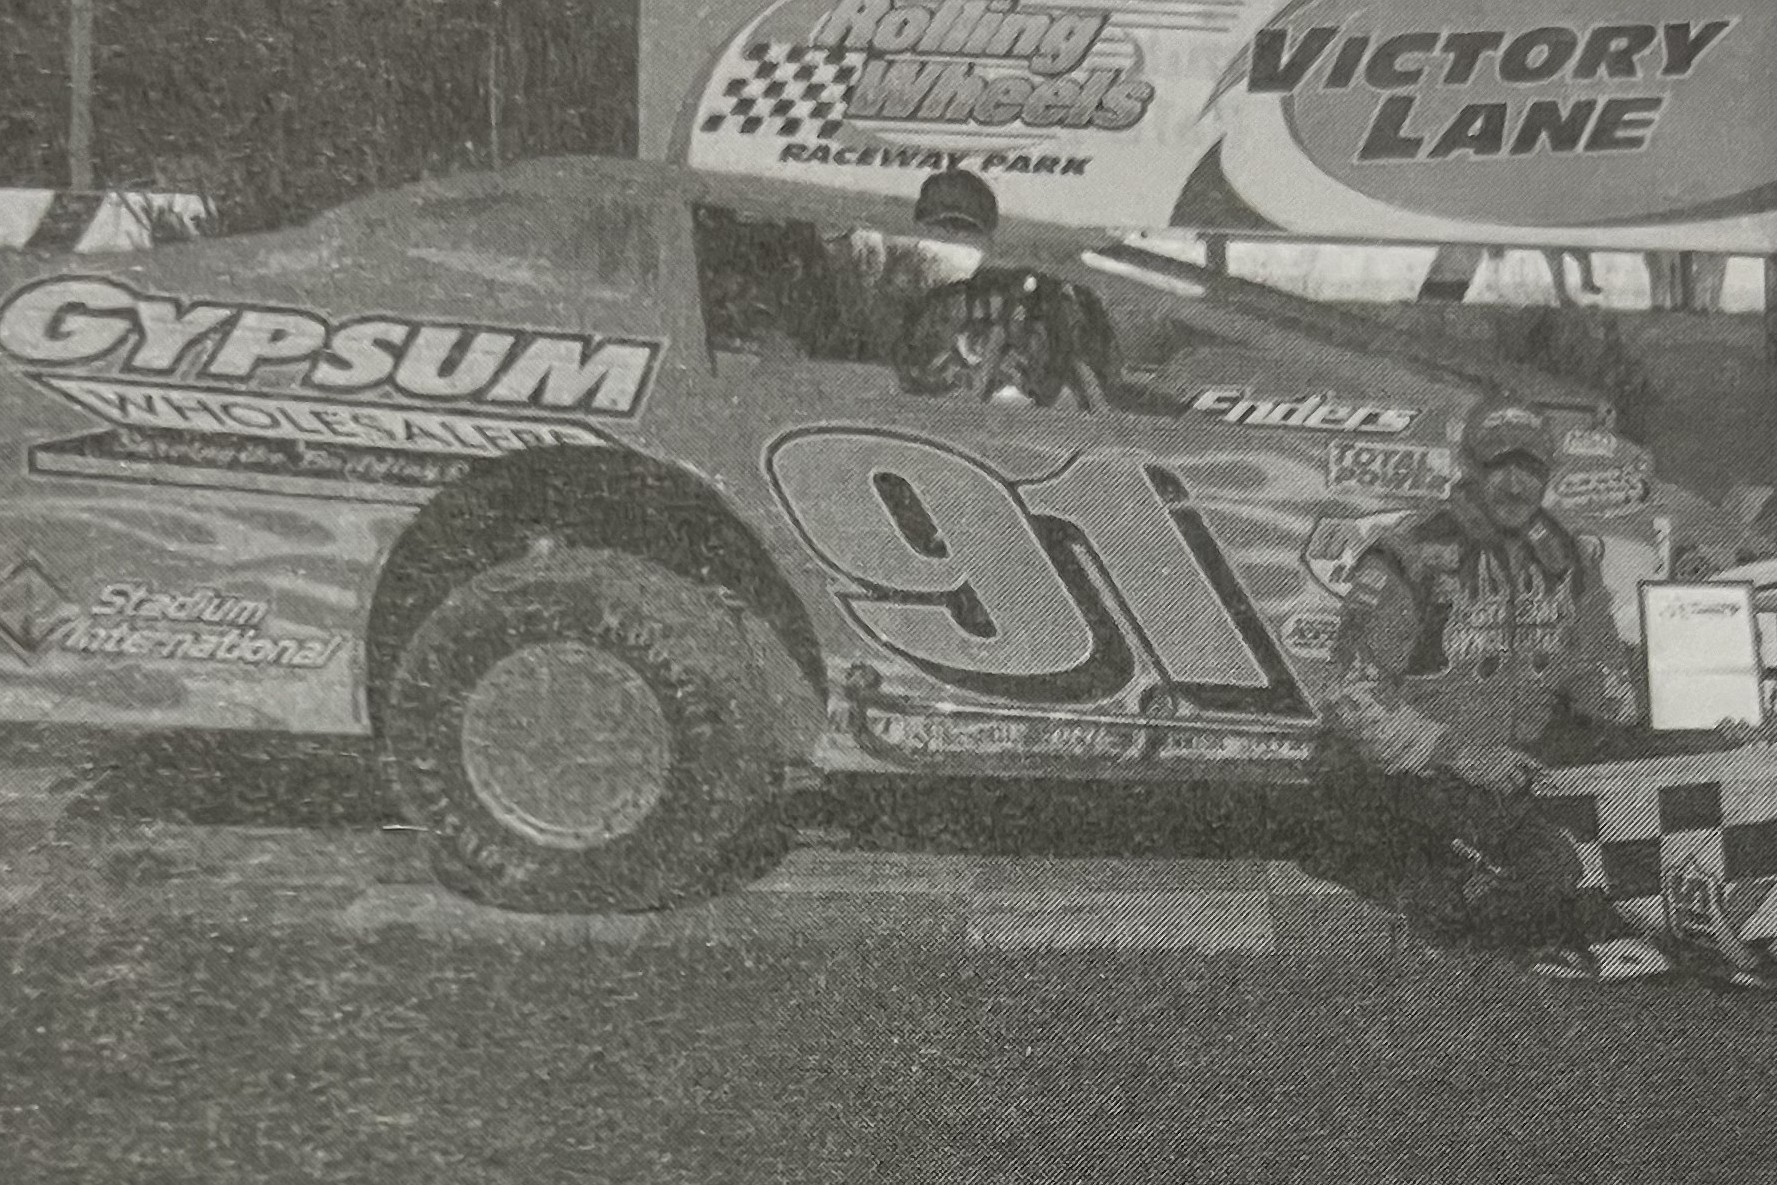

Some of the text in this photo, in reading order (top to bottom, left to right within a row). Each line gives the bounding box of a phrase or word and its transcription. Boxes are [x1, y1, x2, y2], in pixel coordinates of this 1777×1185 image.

[812, 0, 1108, 75] Rolling
[1247, 19, 1736, 93] VICTORY
[846, 57, 1156, 130] Wheels
[1355, 95, 1664, 161] LANE
[779, 143, 1093, 176] RACEWAY PARK
[0, 274, 662, 416] GYPSUM
[91, 579, 269, 627] Stadium
[764, 424, 1322, 724] 91
[60, 615, 346, 669] International
